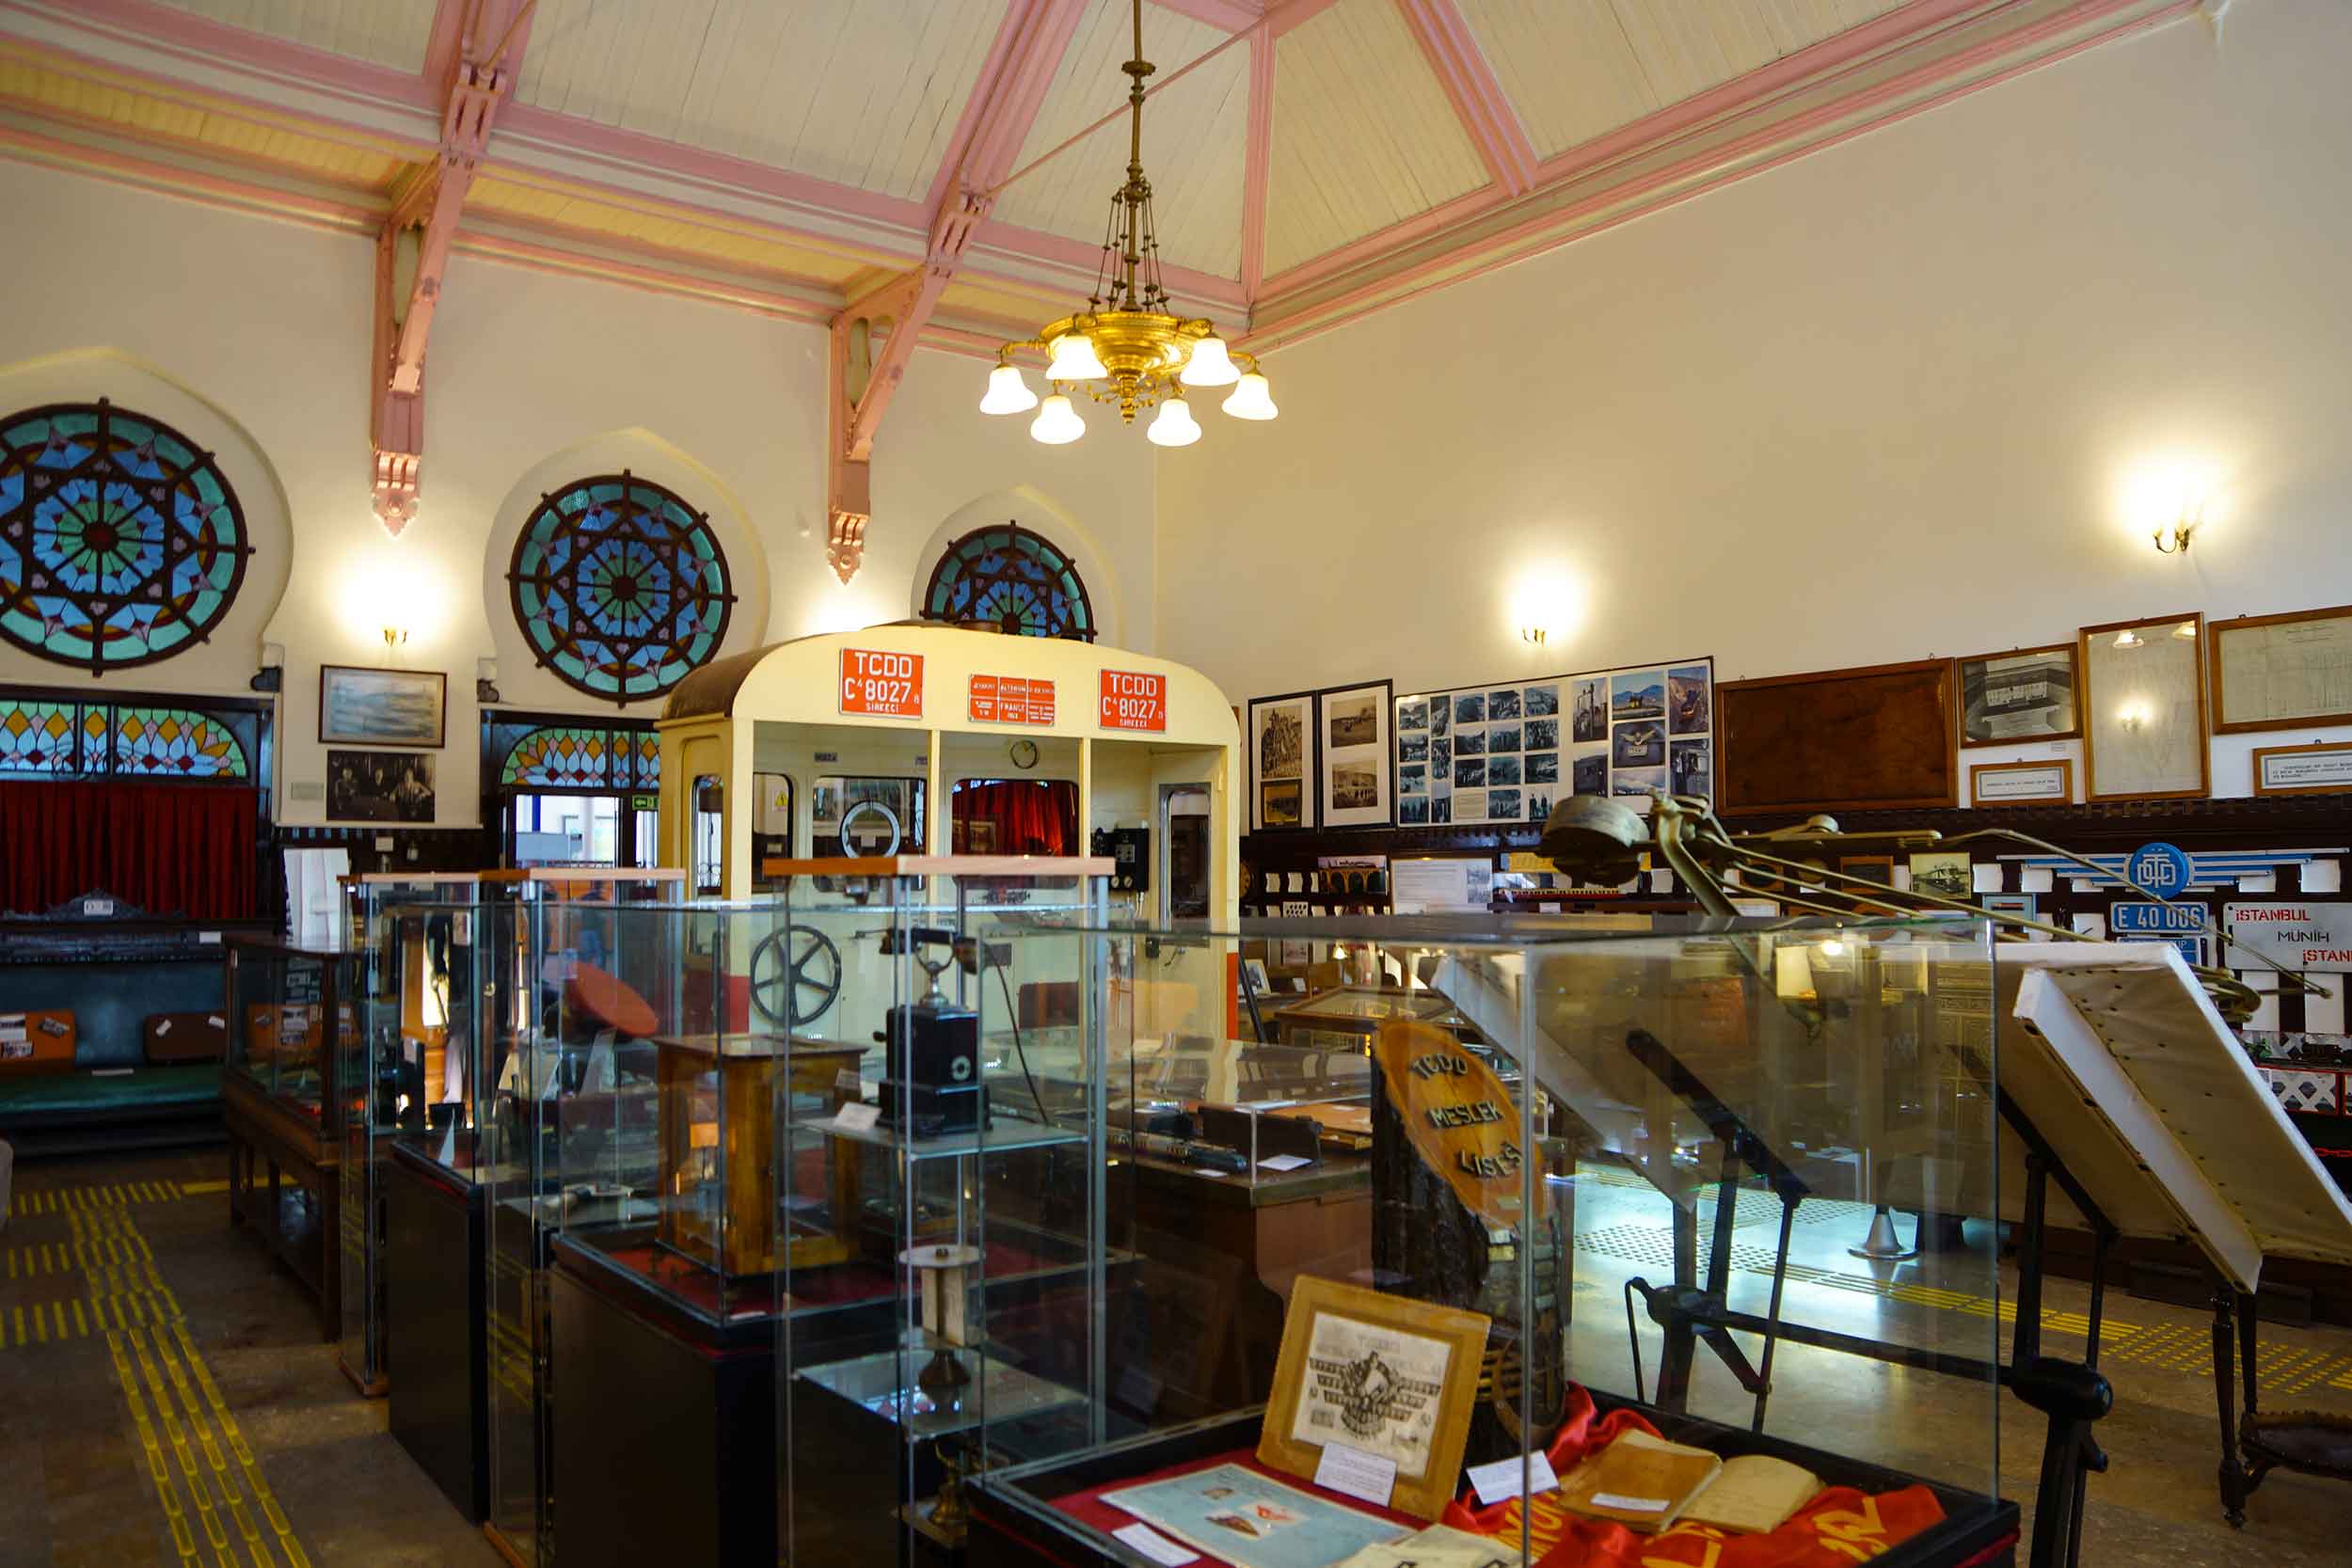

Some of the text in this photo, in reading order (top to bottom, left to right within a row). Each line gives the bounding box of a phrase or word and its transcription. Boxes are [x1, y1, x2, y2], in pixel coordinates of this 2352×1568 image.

[854, 652, 913, 678] TCDD
[1109, 673, 1158, 697] TCDD
[2118, 907, 2129, 927] E
[2137, 907, 2160, 927] 40
[2302, 949, 2352, 962] İSTAN
[1428, 1100, 1505, 1129] MESLEK
